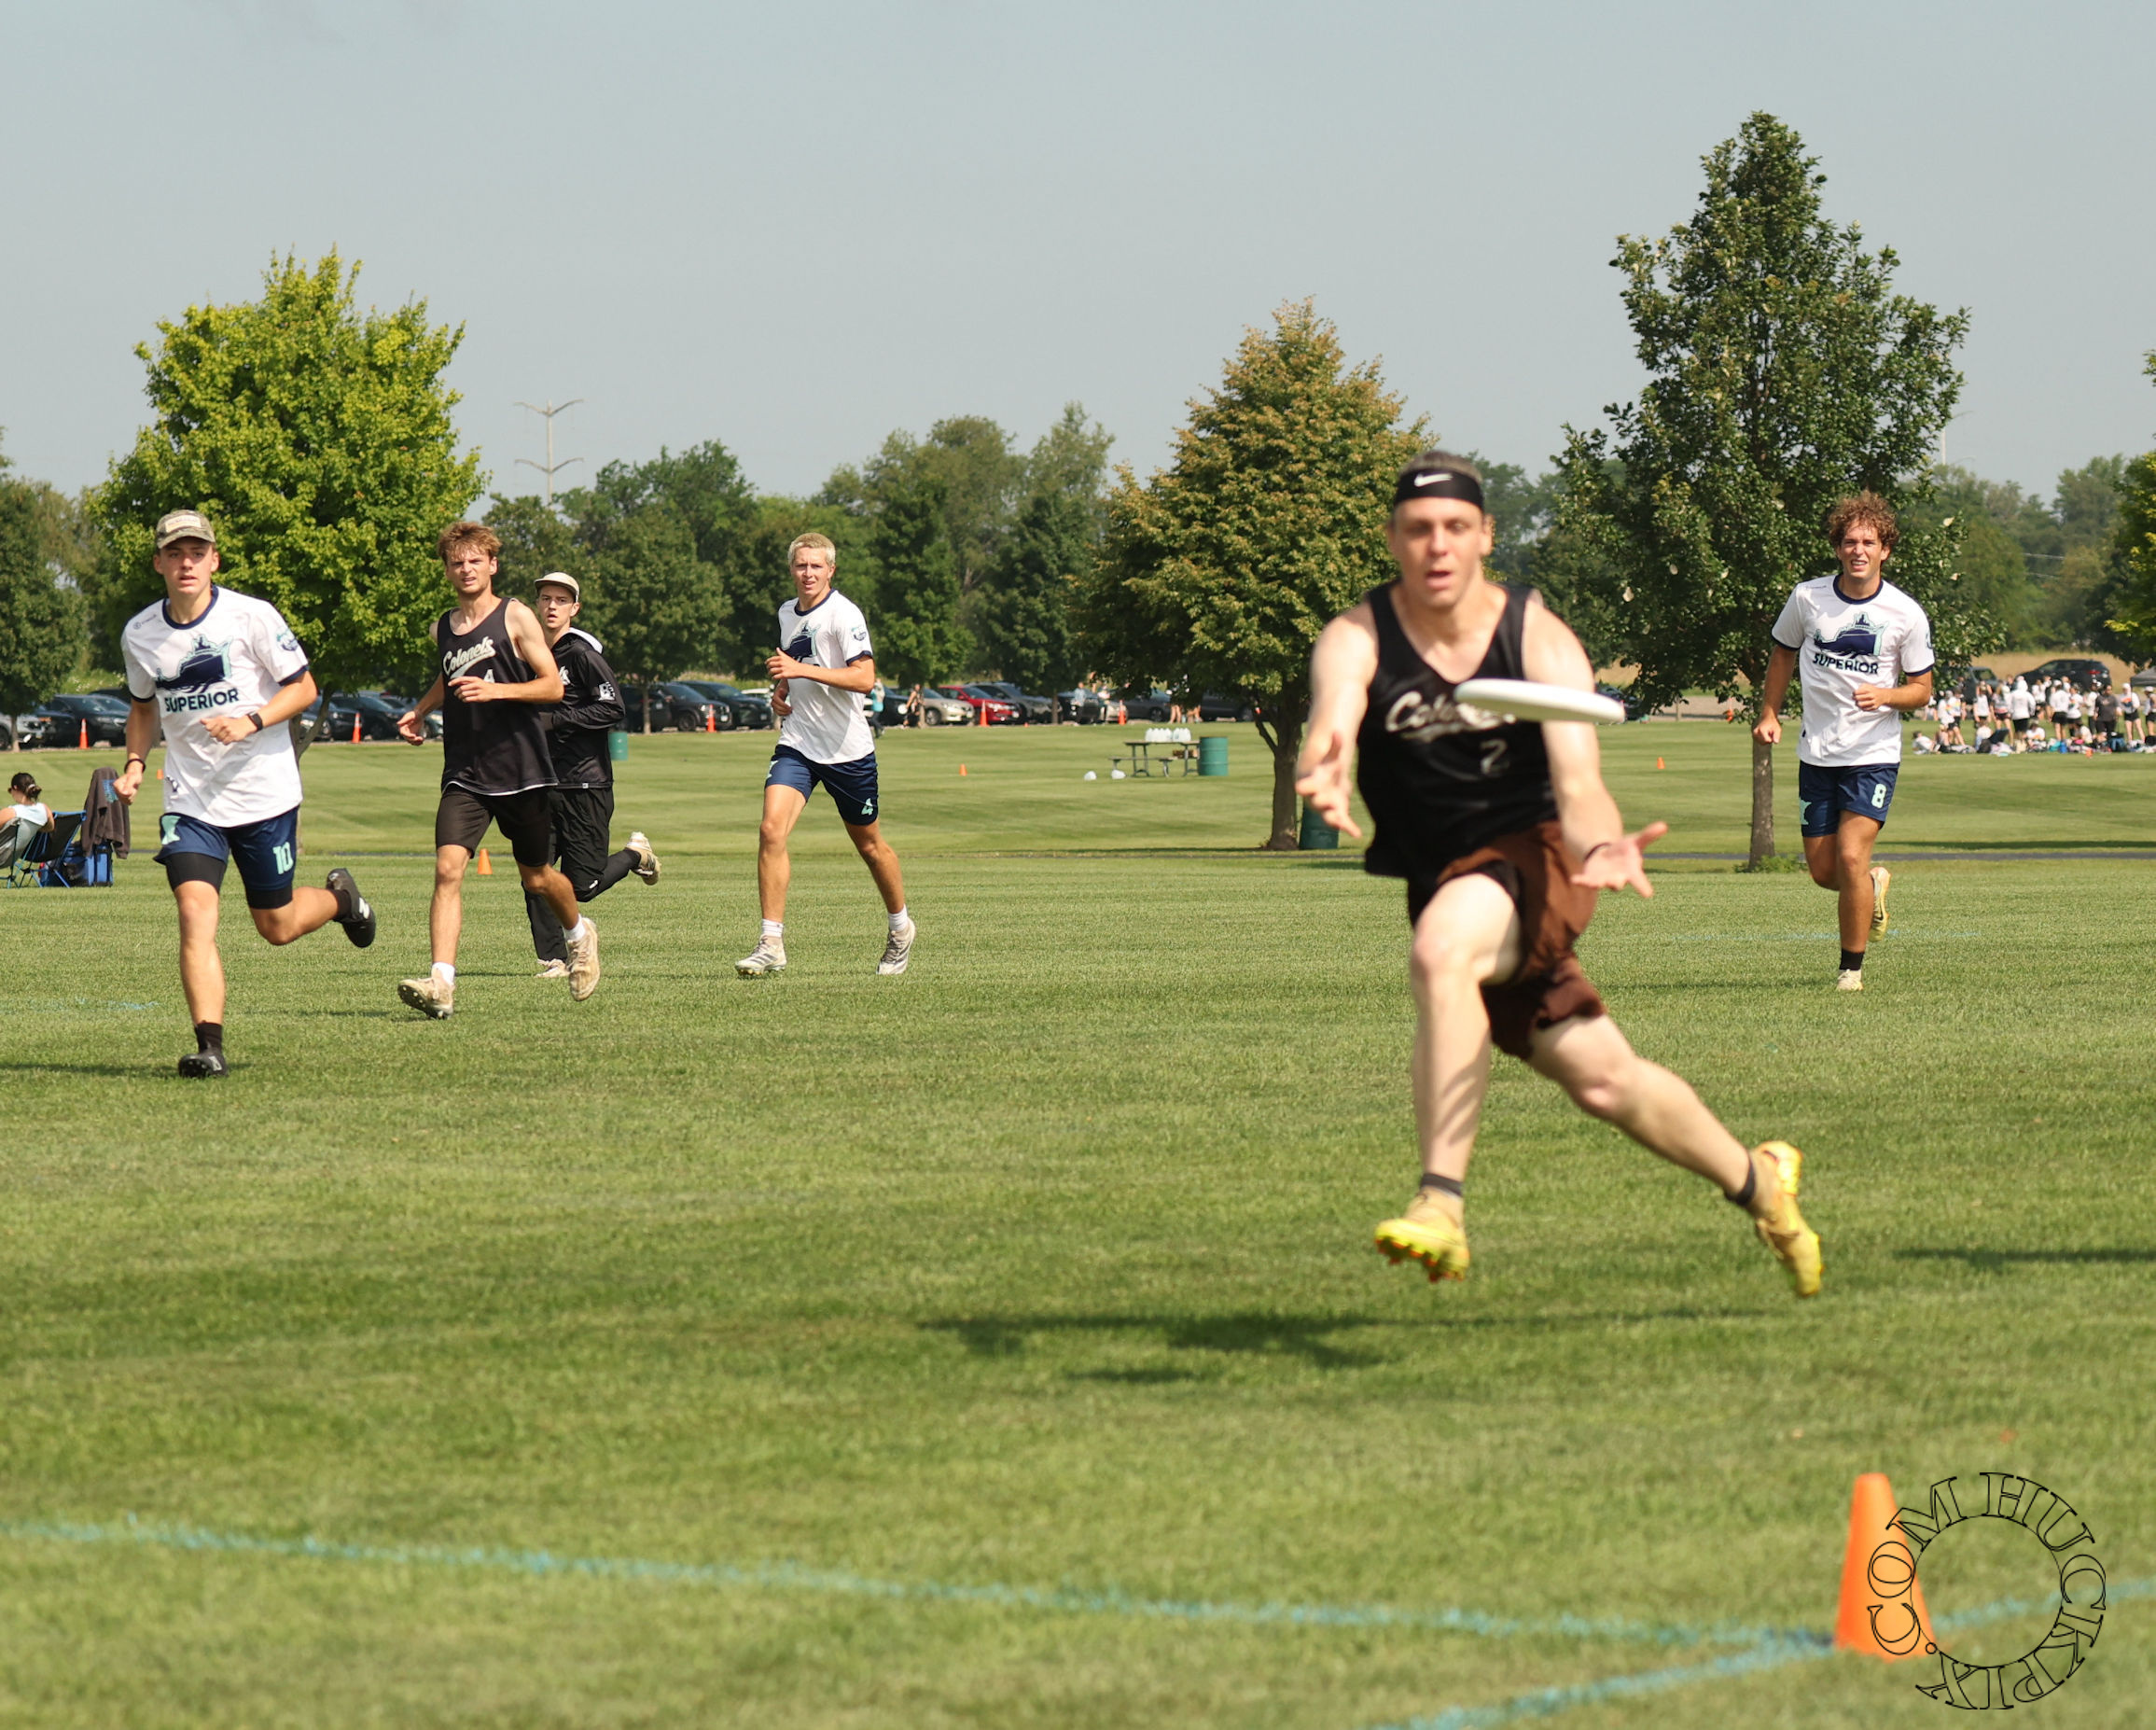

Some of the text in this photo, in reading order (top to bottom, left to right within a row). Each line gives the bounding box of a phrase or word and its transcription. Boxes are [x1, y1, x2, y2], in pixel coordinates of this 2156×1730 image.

[443, 635, 496, 674] Colonels
[1813, 653, 1879, 675] SUPERIOR
[164, 689, 239, 713] SUPERIOR
[861, 798, 874, 816] 4
[1871, 784, 1887, 808] 8
[273, 842, 294, 874] 10
